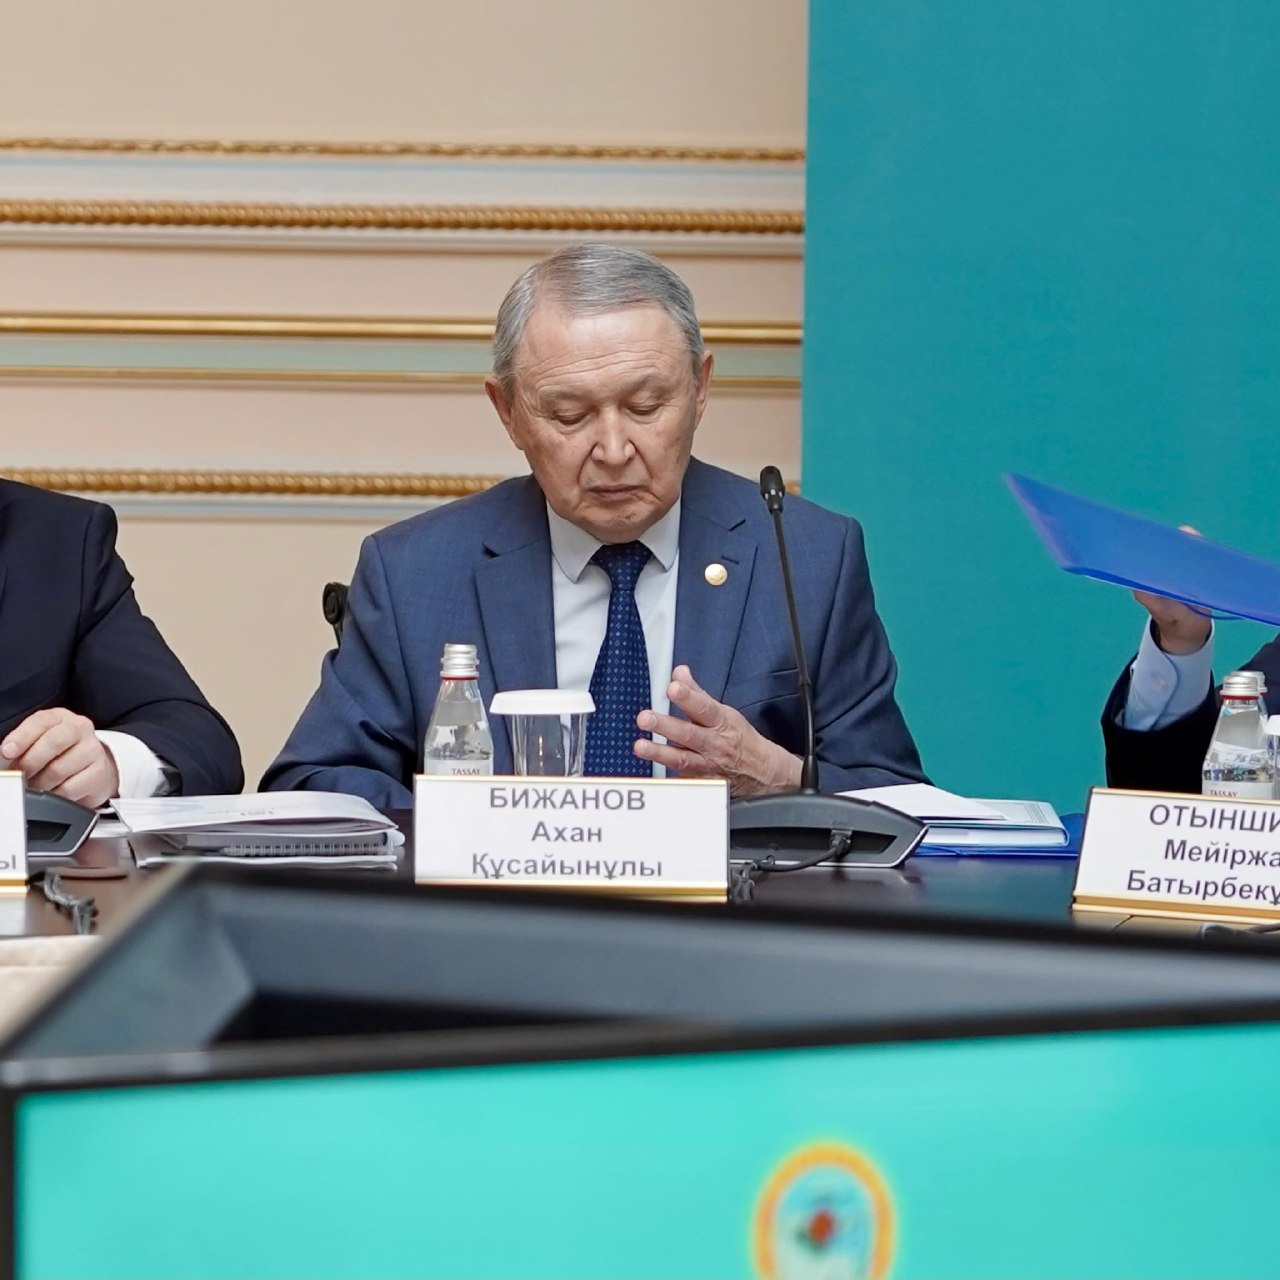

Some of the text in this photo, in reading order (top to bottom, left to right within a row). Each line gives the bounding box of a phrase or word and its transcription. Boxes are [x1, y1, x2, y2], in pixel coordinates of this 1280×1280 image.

[490, 787, 645, 810] БИЖАНОВ
[531, 821, 602, 843] Ахан
[472, 853, 662, 880] Құсайынұлы
